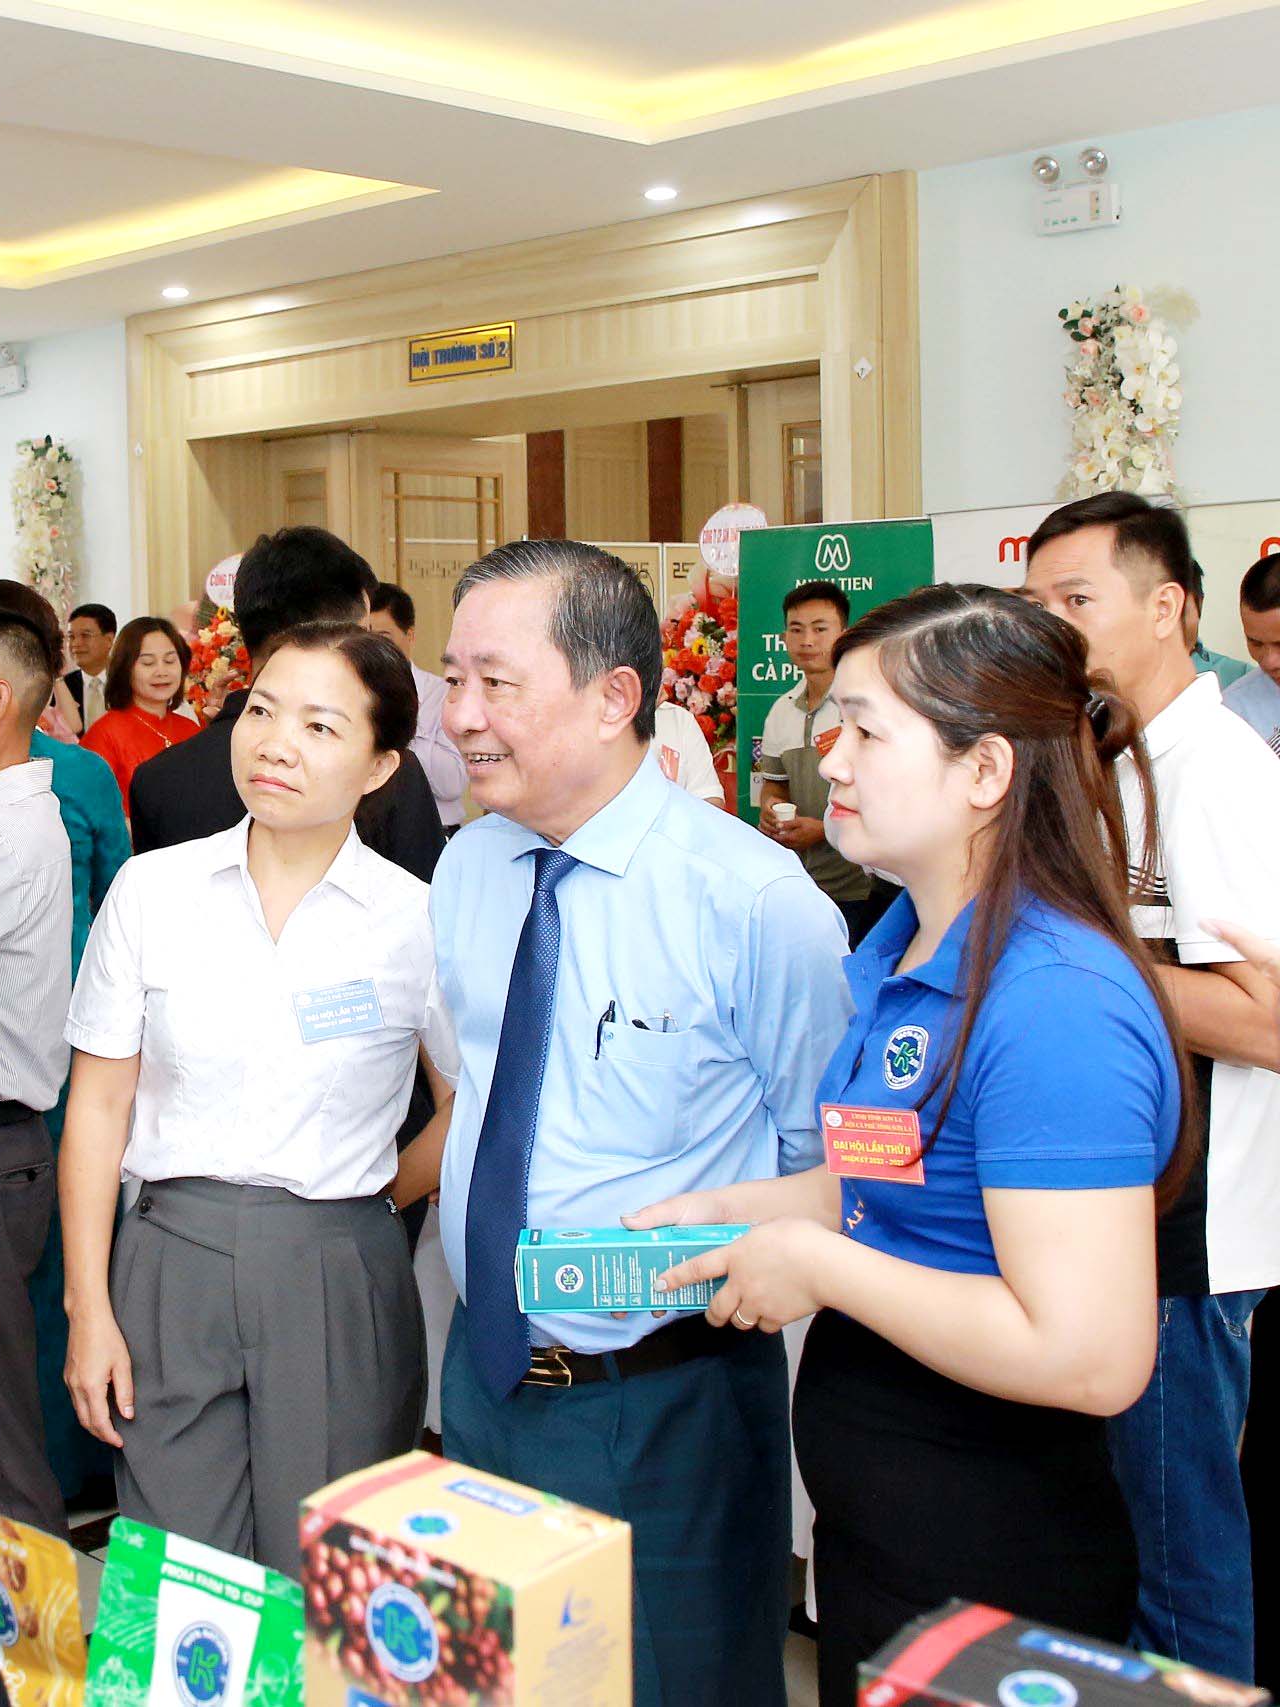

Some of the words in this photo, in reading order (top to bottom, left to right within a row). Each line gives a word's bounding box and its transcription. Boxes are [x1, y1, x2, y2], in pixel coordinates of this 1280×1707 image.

[498, 342, 508, 357] 2
[838, 577, 873, 591] TIEN
[752, 658, 778, 681] CÀ
[782, 663, 805, 681] PH
